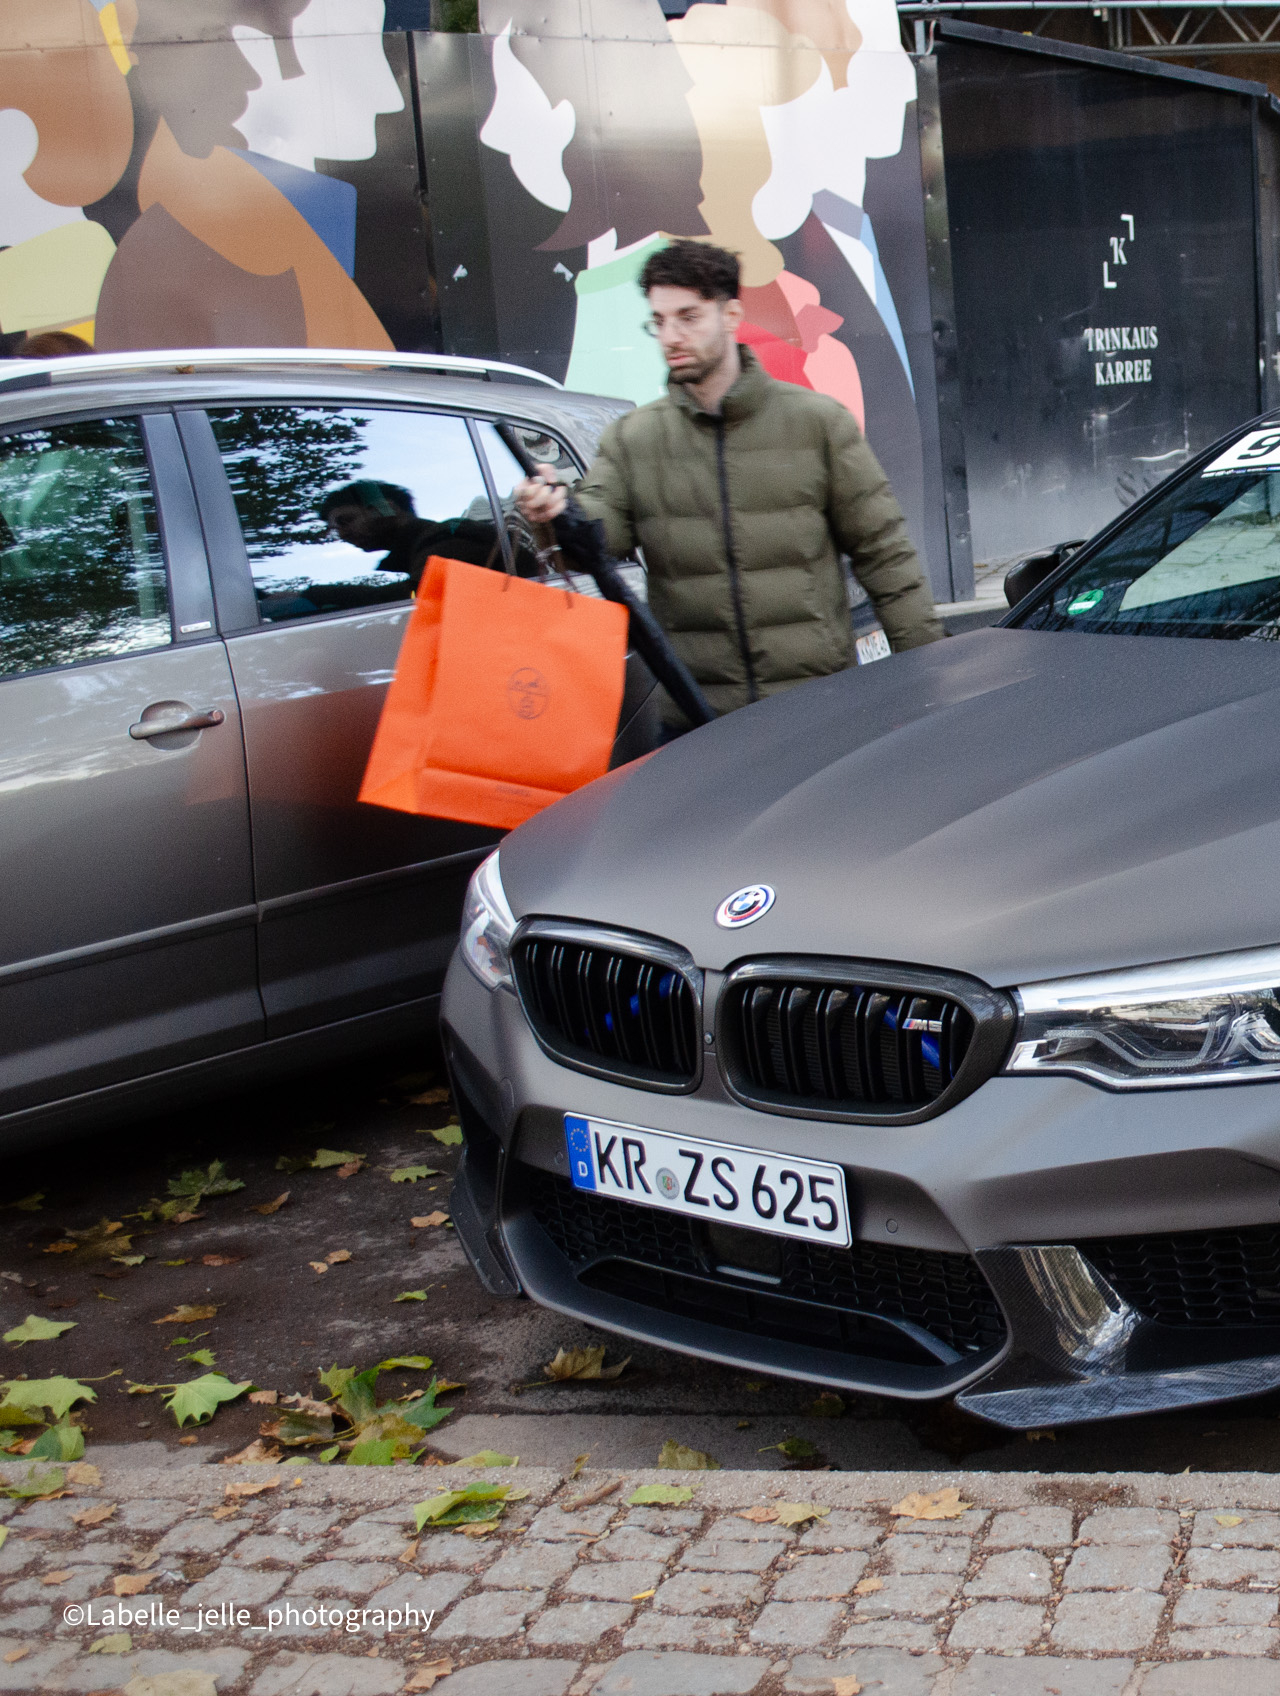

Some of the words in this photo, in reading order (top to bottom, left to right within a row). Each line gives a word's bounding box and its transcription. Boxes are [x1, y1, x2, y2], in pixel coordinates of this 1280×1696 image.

[1083, 326, 1159, 352] TRINKAUS
[1095, 359, 1152, 386] KARREE
[911, 1018, 942, 1032] M5
[578, 1160, 589, 1177] D
[594, 1130, 653, 1195] KR
[678, 1148, 740, 1211] ZS
[751, 1164, 840, 1232] 625
